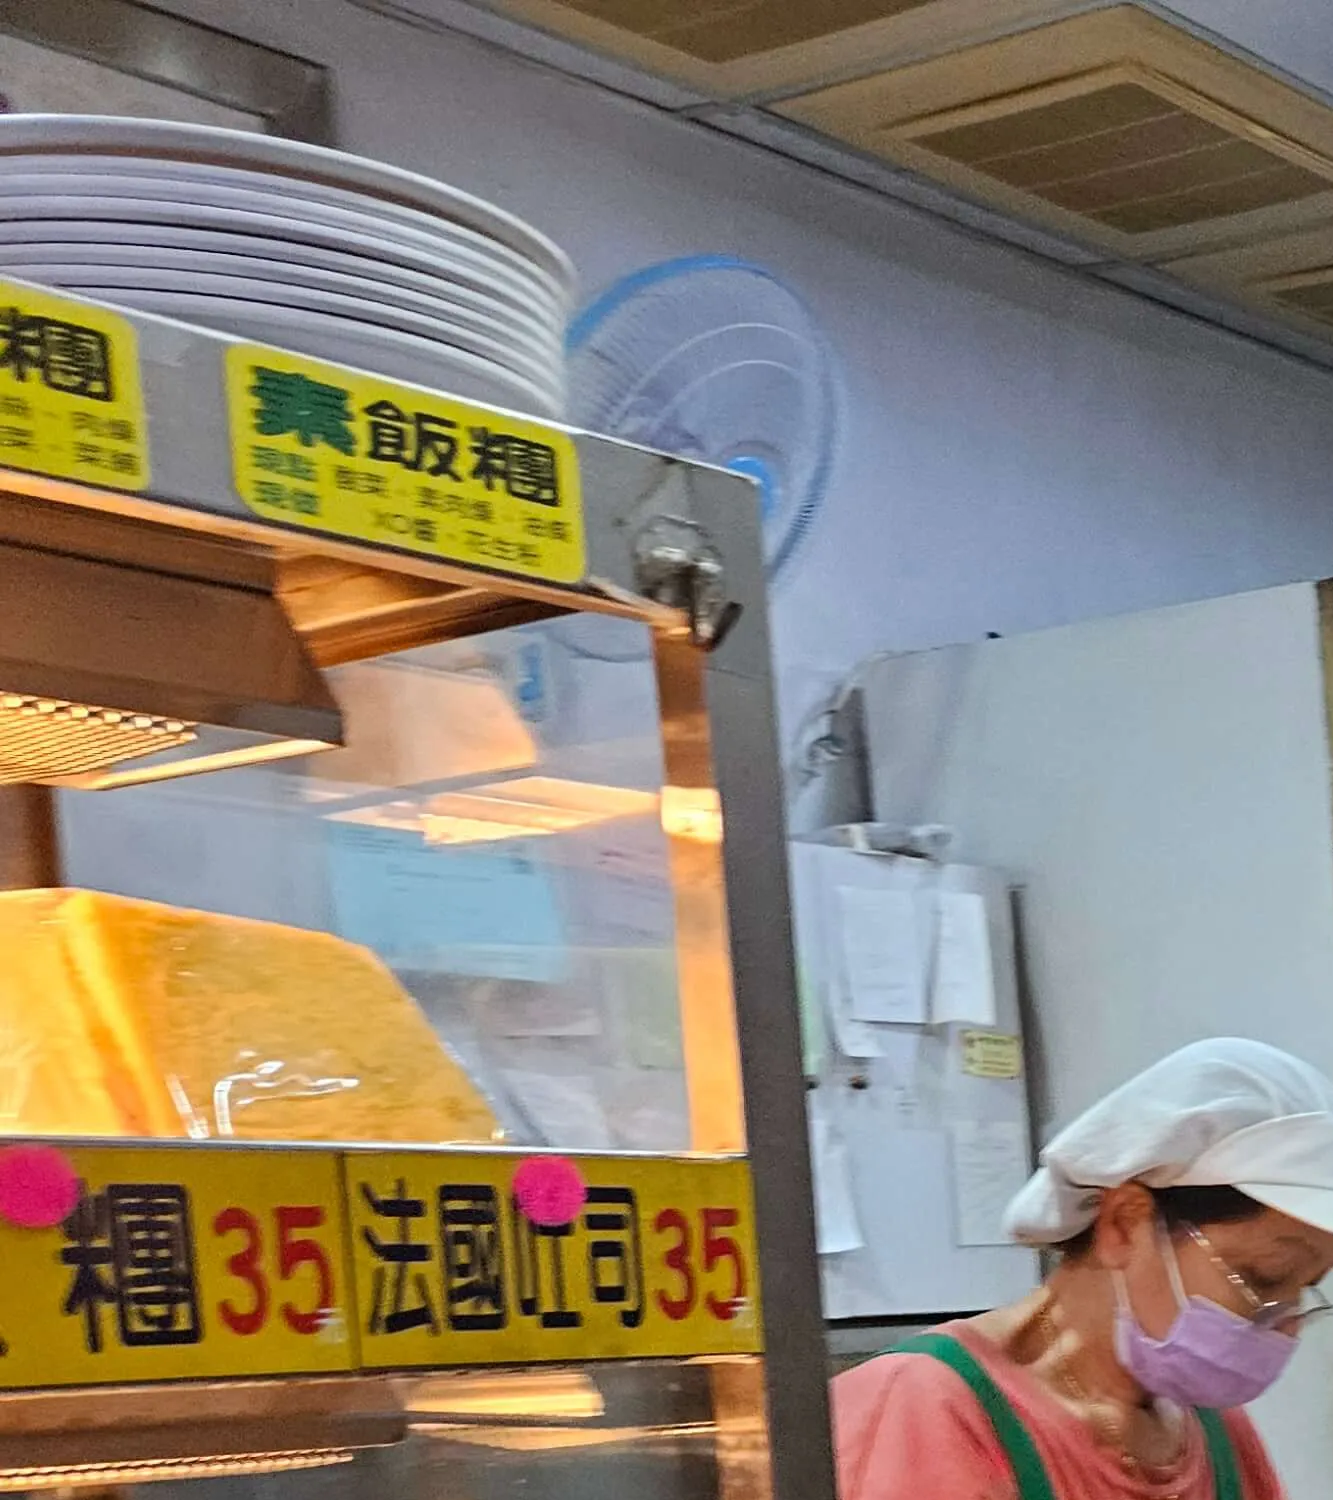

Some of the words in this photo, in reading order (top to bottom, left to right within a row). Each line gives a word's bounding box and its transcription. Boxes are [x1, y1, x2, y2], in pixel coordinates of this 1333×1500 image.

[250, 364, 563, 508] 素飯糰
[213, 1205, 337, 1336] 35
[653, 1206, 748, 1321] 35
